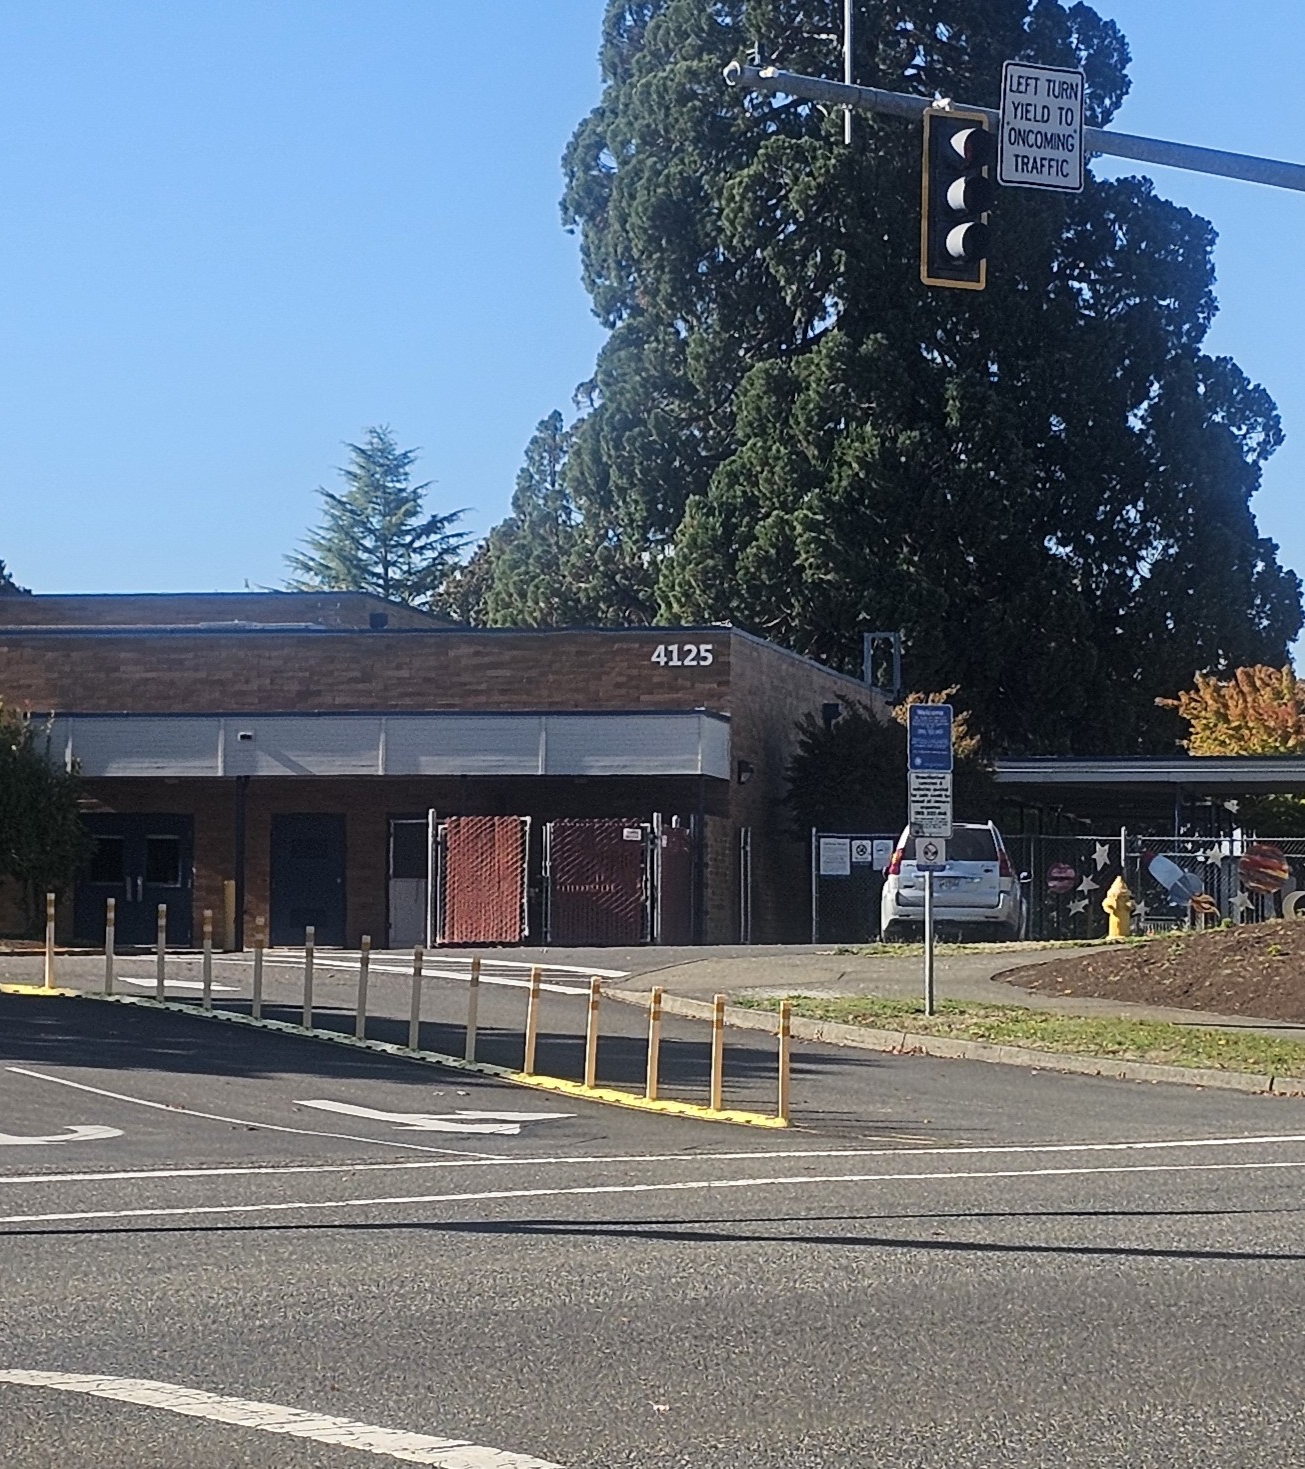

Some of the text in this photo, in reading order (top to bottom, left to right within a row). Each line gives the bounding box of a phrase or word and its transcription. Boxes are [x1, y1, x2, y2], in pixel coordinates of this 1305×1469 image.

[1009, 74, 1079, 101] LEFT TURN
[1011, 100, 1074, 127] YIELD TO
[1008, 127, 1075, 153] ONCOMING
[1013, 154, 1070, 178] TRAFFIC
[651, 643, 713, 666] 4125
